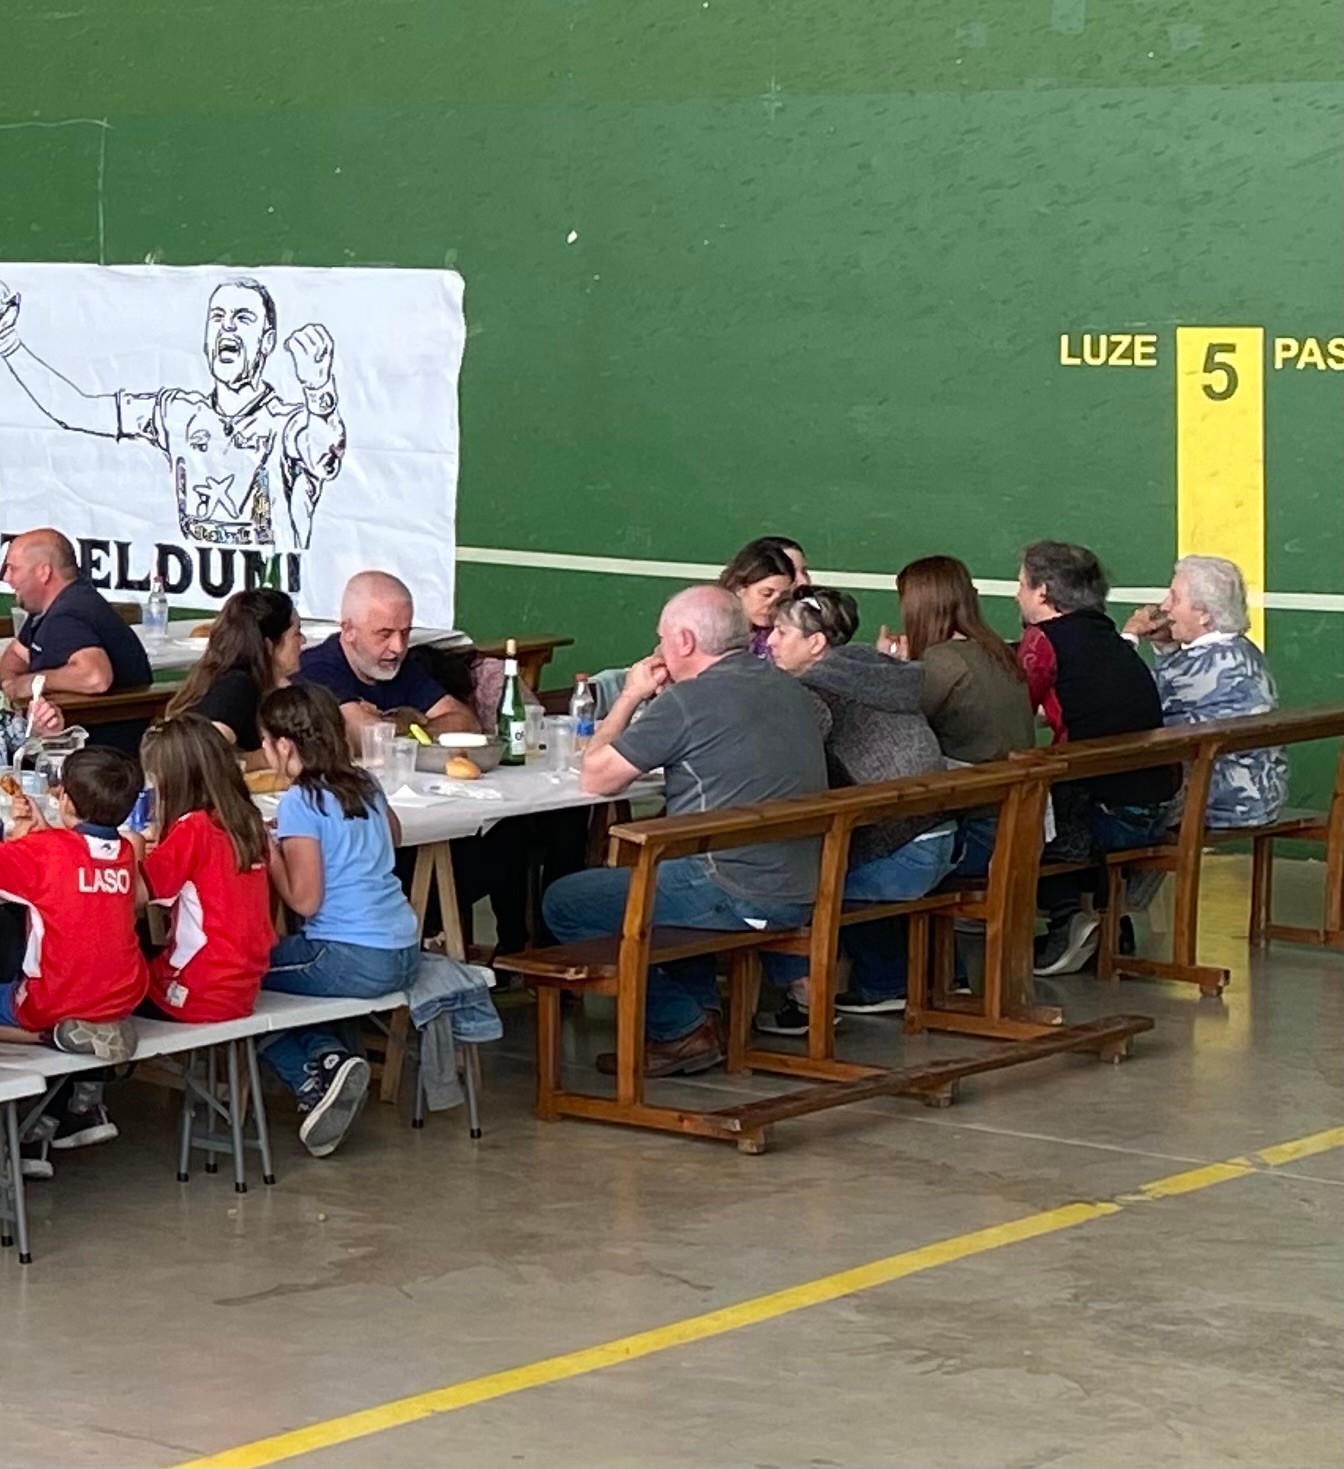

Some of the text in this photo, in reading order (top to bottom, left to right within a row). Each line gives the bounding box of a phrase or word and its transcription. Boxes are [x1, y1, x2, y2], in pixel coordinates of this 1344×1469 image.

[1060, 334, 1344, 401] LUZE 5 PAS
[78, 867, 131, 894] LASO
